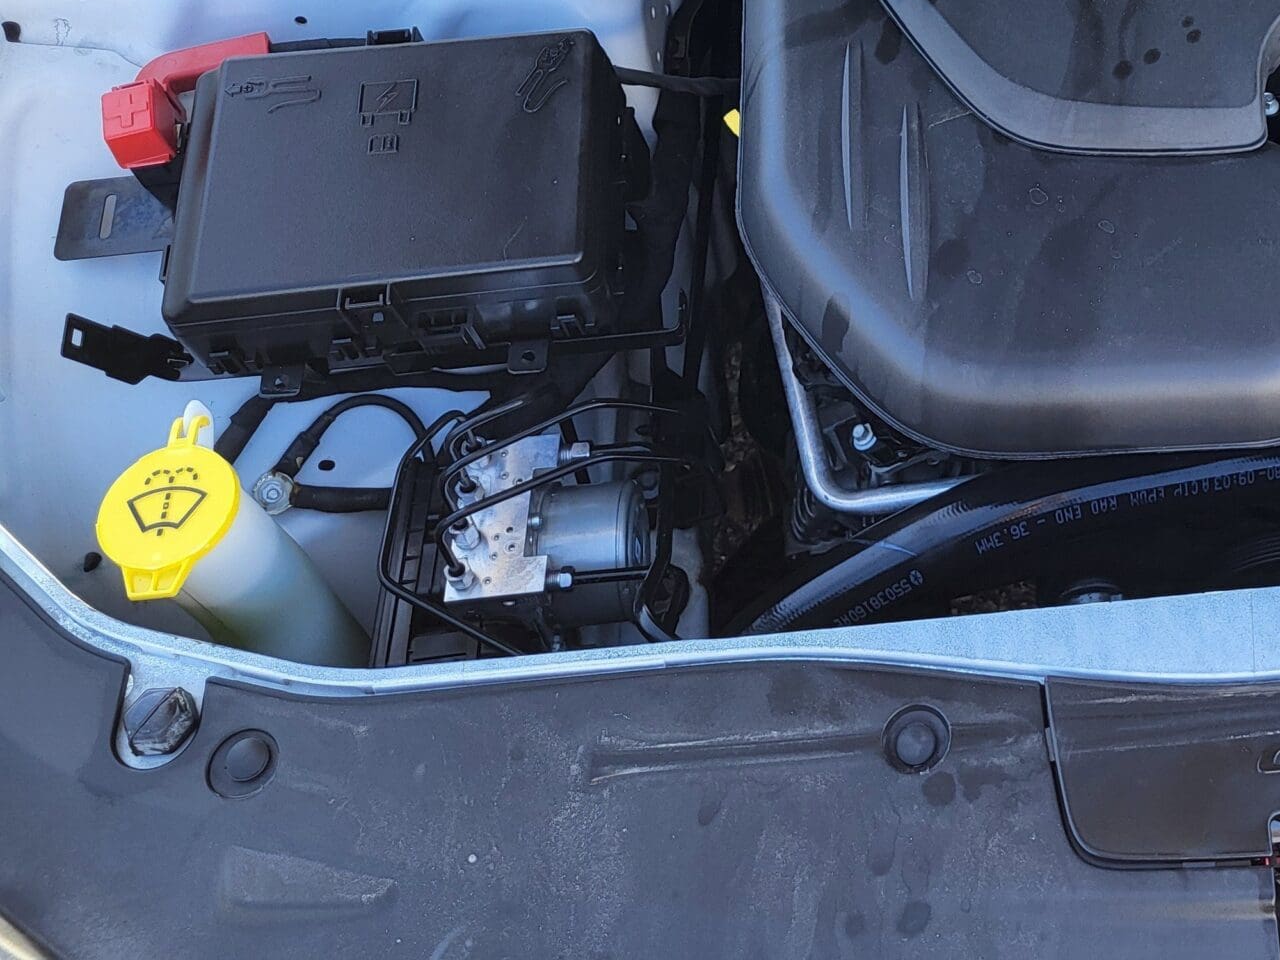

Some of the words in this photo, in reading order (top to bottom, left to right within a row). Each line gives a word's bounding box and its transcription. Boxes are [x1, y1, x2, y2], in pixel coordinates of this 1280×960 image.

[1055, 505, 1082, 525] END
[1090, 497, 1118, 516] RAD
[975, 520, 1030, 554] 36.3MM
